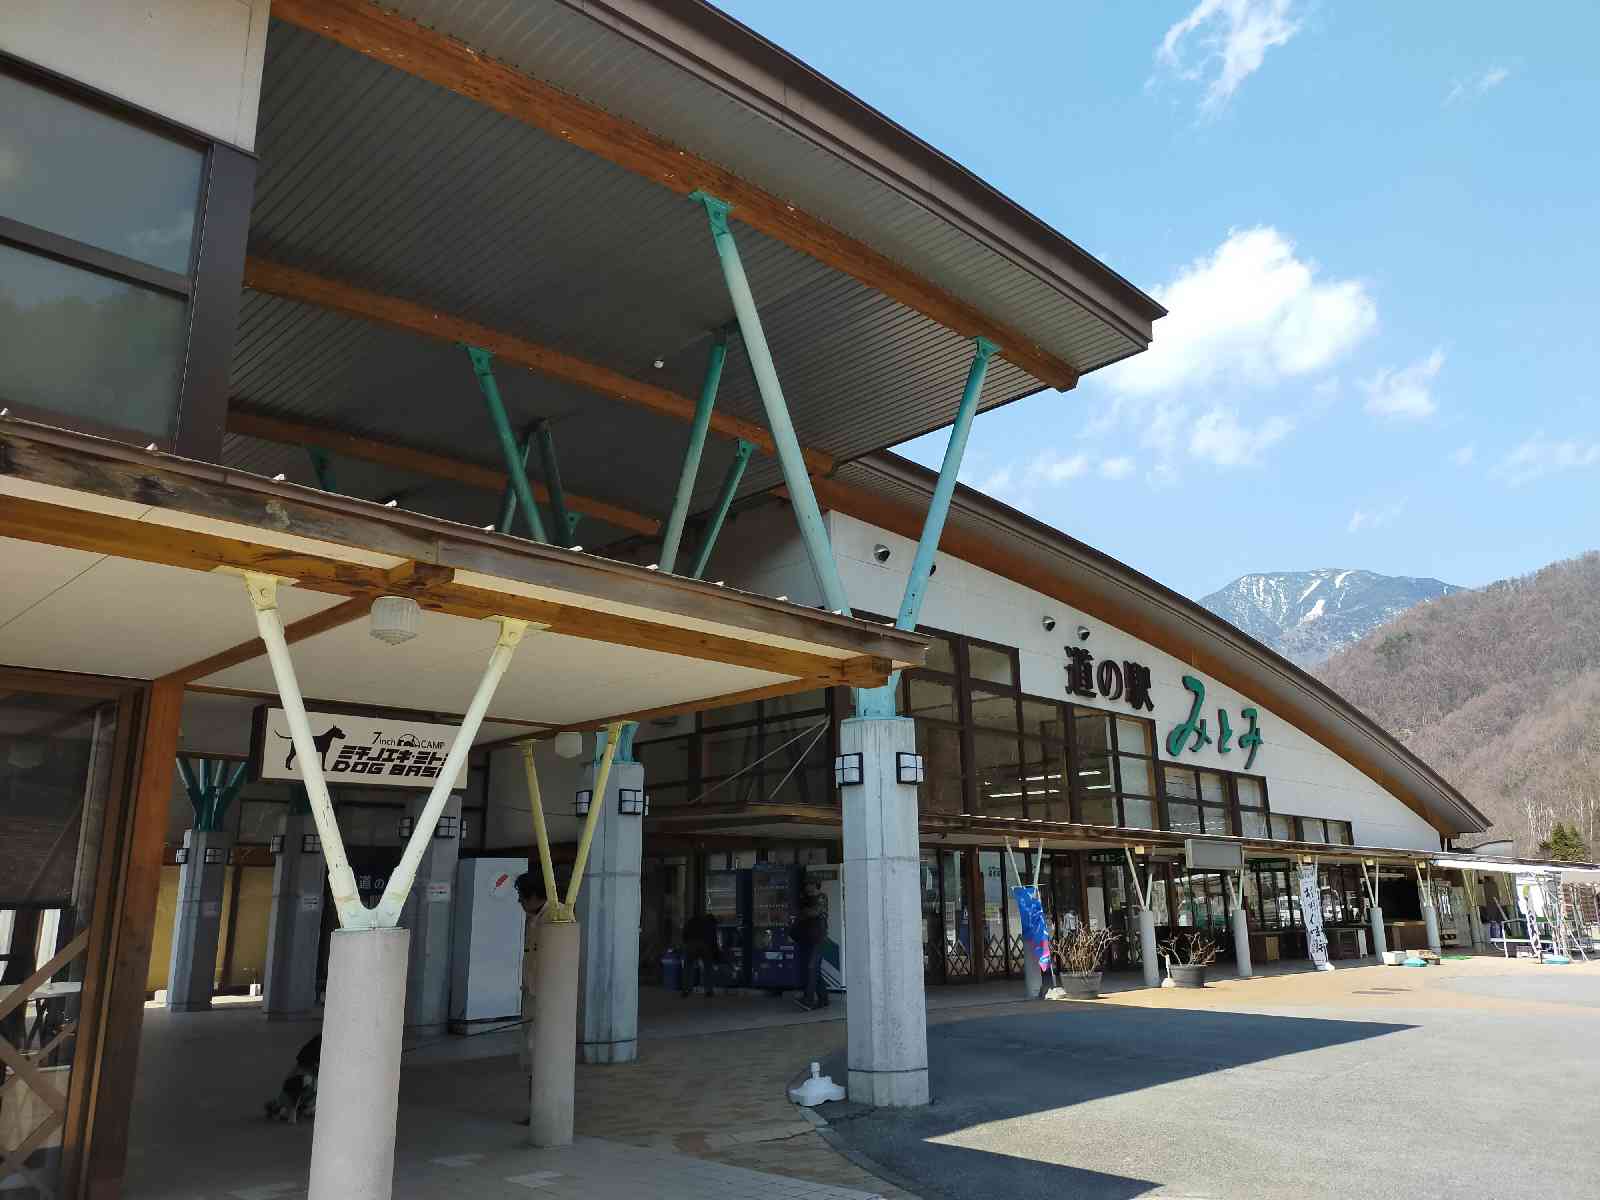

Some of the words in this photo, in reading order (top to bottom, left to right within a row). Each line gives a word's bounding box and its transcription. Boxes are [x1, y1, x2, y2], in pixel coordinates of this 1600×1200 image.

[1064, 645, 1154, 712] 道の駅
[1166, 675, 1264, 770] みとみ
[421, 740, 445, 749] CAMP
[331, 760, 385, 775] DOG
